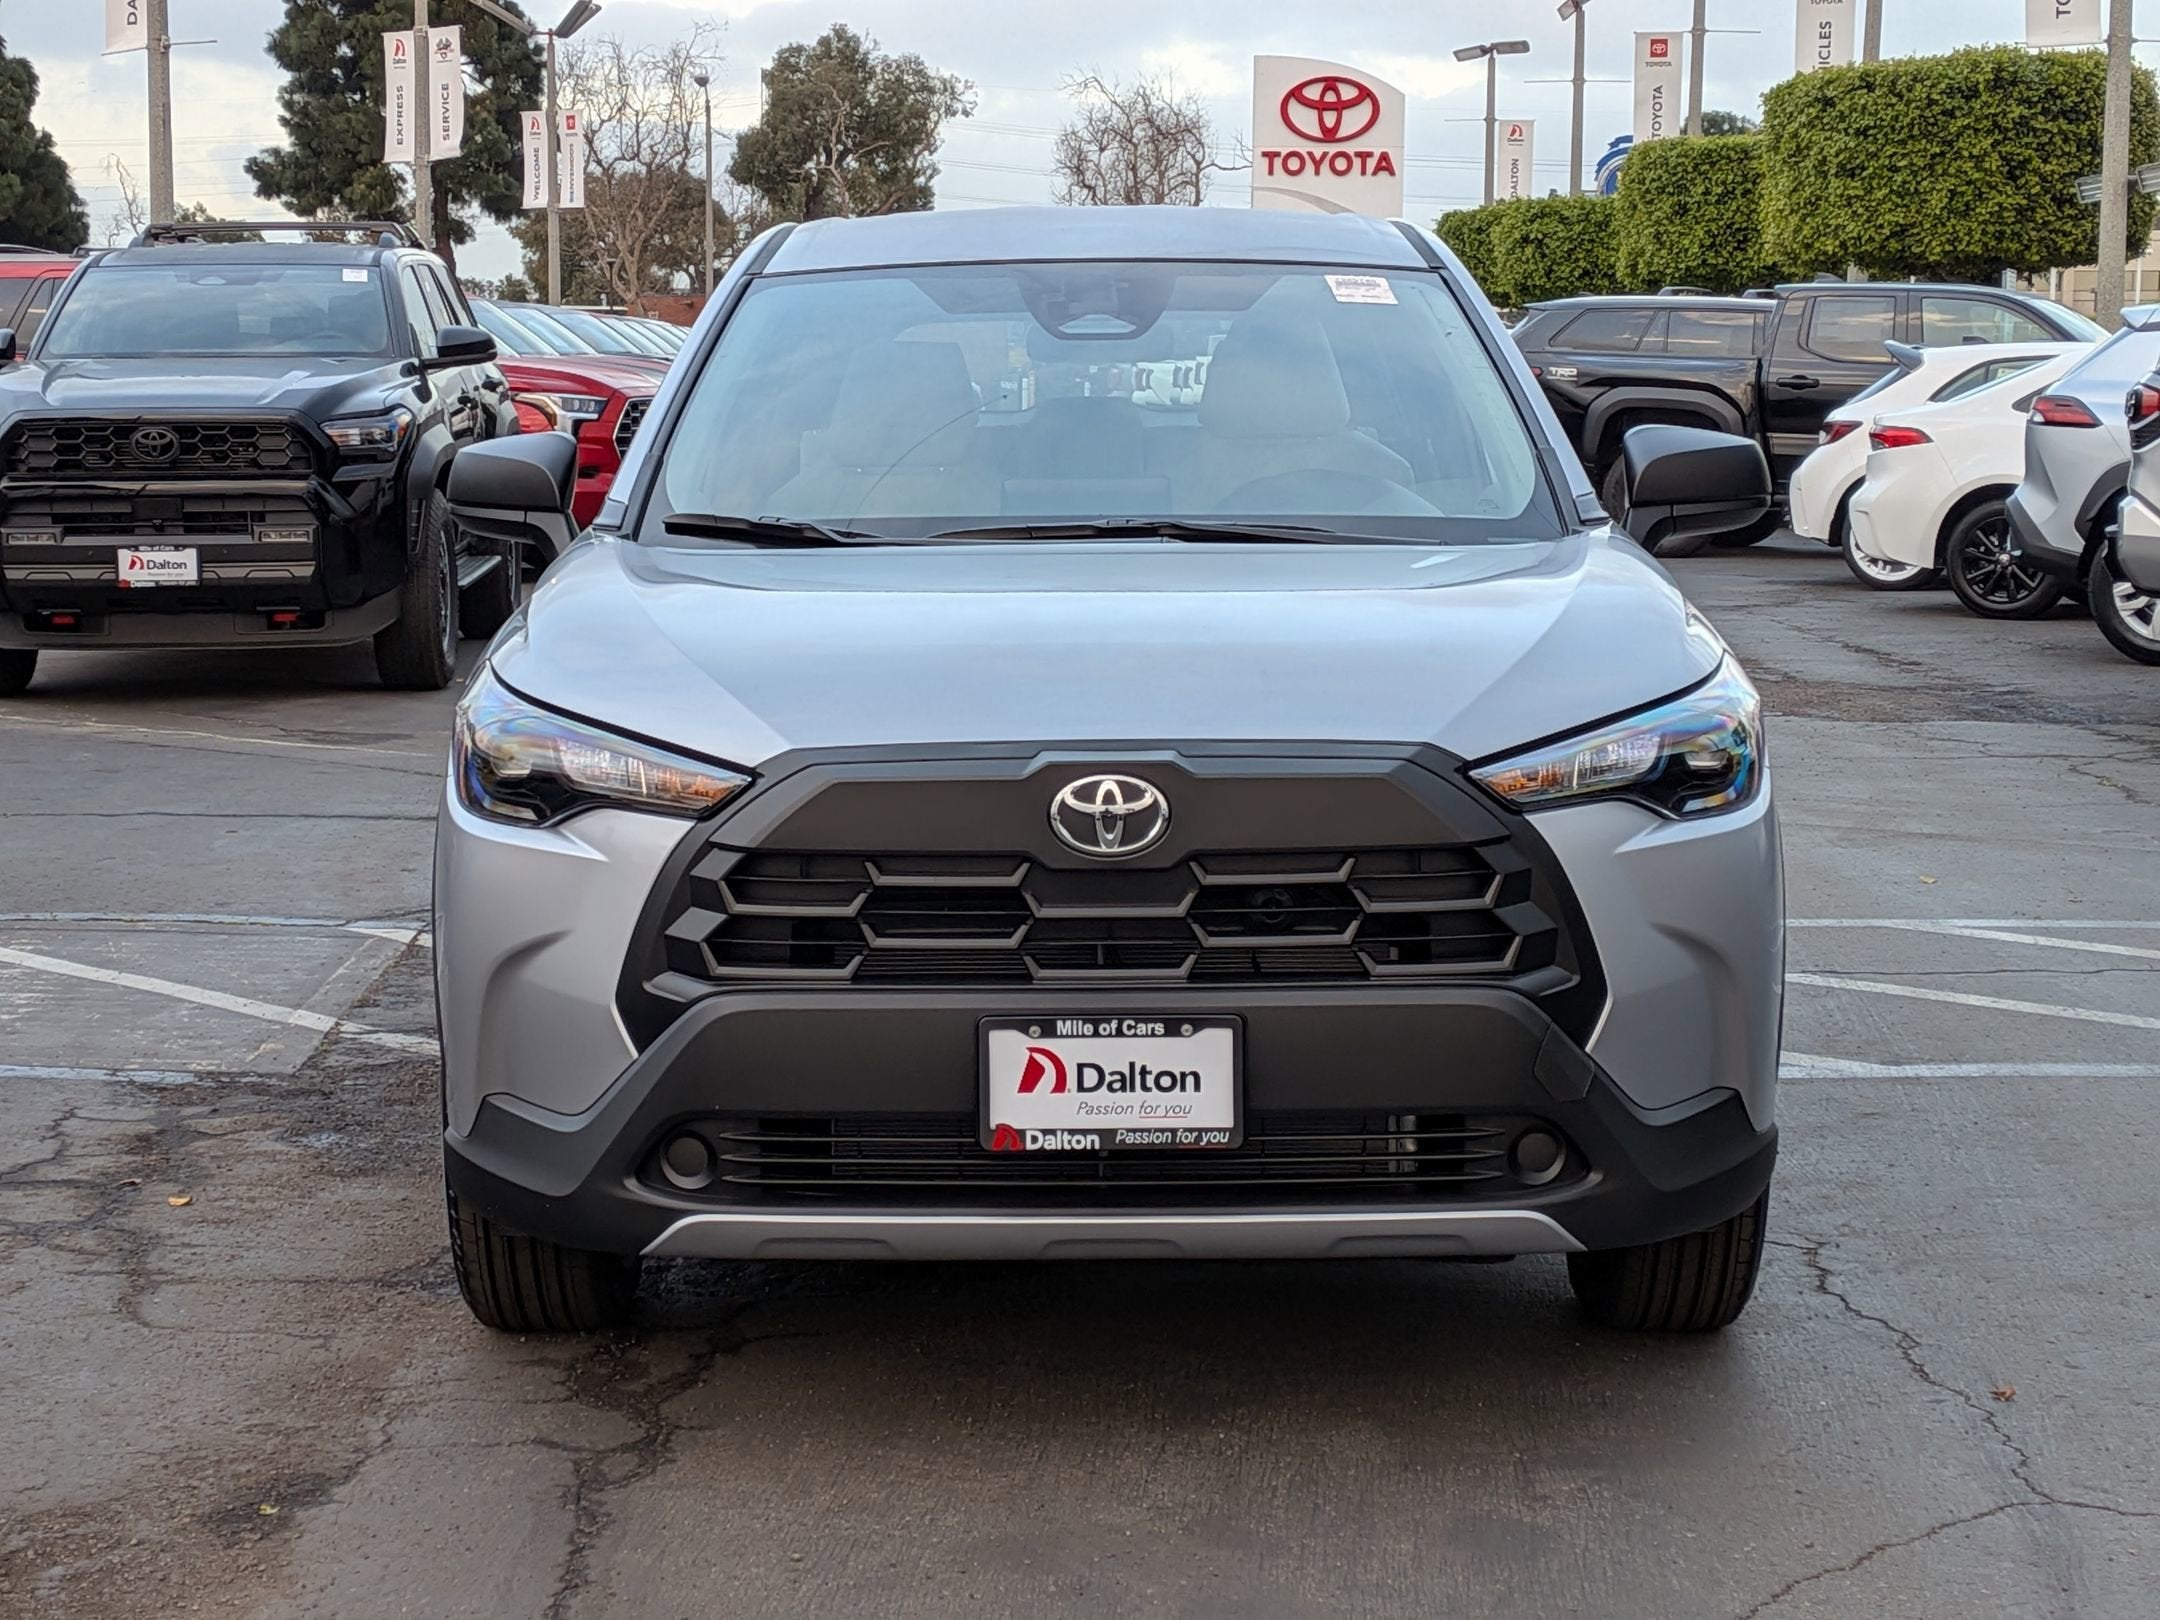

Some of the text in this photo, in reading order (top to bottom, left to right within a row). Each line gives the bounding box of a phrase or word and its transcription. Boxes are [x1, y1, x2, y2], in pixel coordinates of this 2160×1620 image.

[1818, 21, 1832, 70] ICLES
[396, 85, 404, 145] EXPRESS
[441, 82, 450, 141] SERVICE
[1652, 84, 1663, 139] TOYOTA
[533, 147, 541, 201] WELCOME
[1261, 150, 1396, 177] TOYOTA
[1510, 158, 1519, 199] DALTON
[146, 559, 187, 570] Dalton
[1056, 1019, 1165, 1036] Mile of Cars
[1076, 1061, 1201, 1094] Dalton
[1076, 1100, 1192, 1117] Passion for you
[1026, 1130, 1100, 1150] Dalton
[1116, 1128, 1229, 1146] Passion for you
